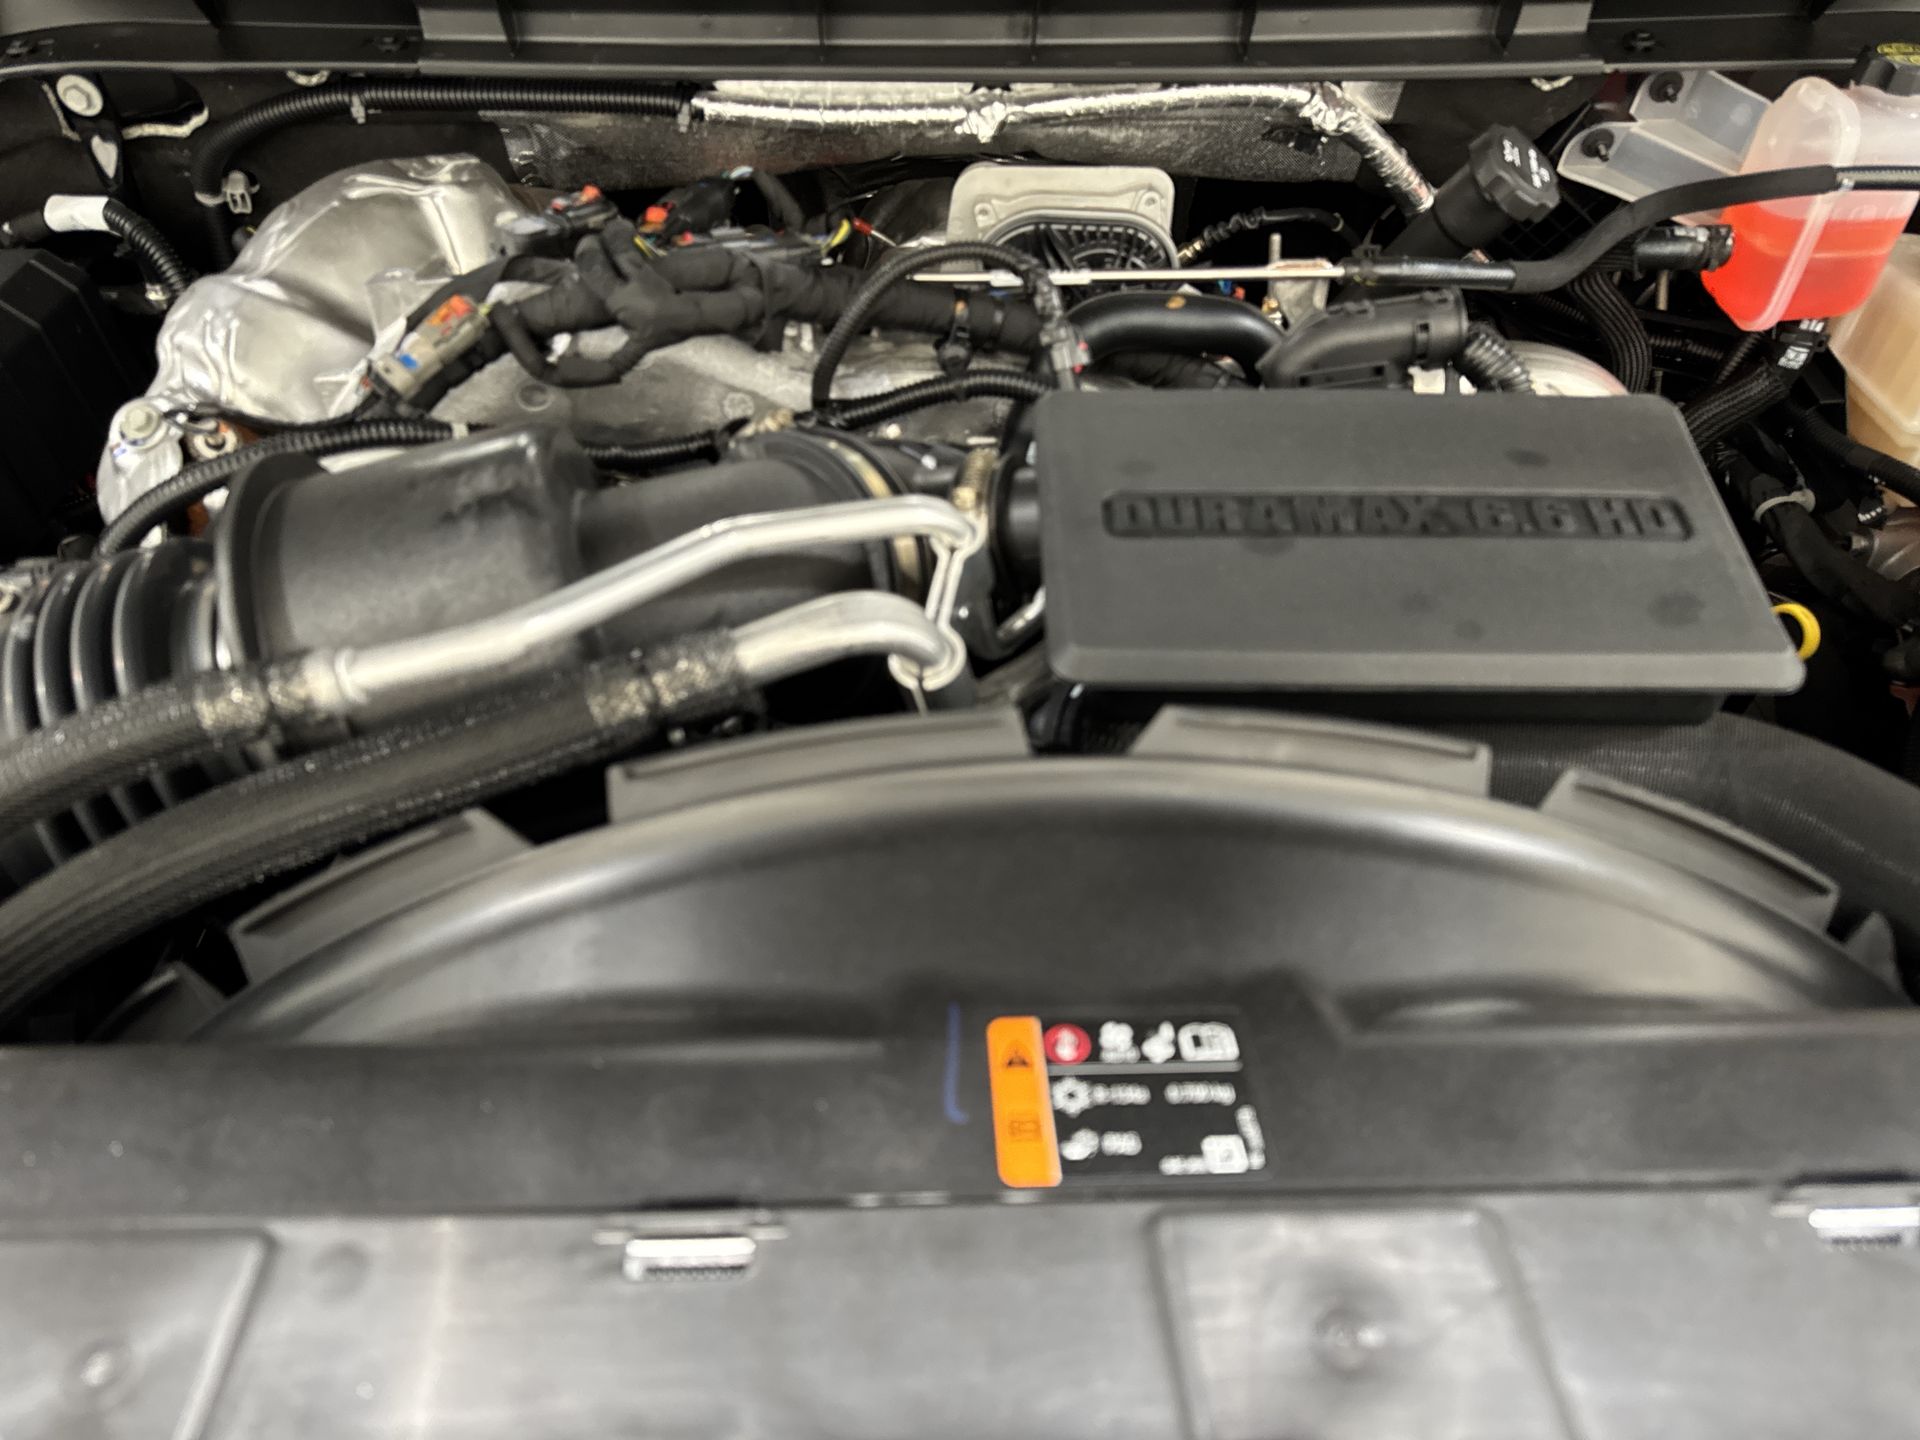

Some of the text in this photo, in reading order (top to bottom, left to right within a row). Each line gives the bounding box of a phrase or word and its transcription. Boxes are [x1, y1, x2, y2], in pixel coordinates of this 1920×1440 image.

[1111, 497, 1685, 537] DURAMAX 6.6 HD
